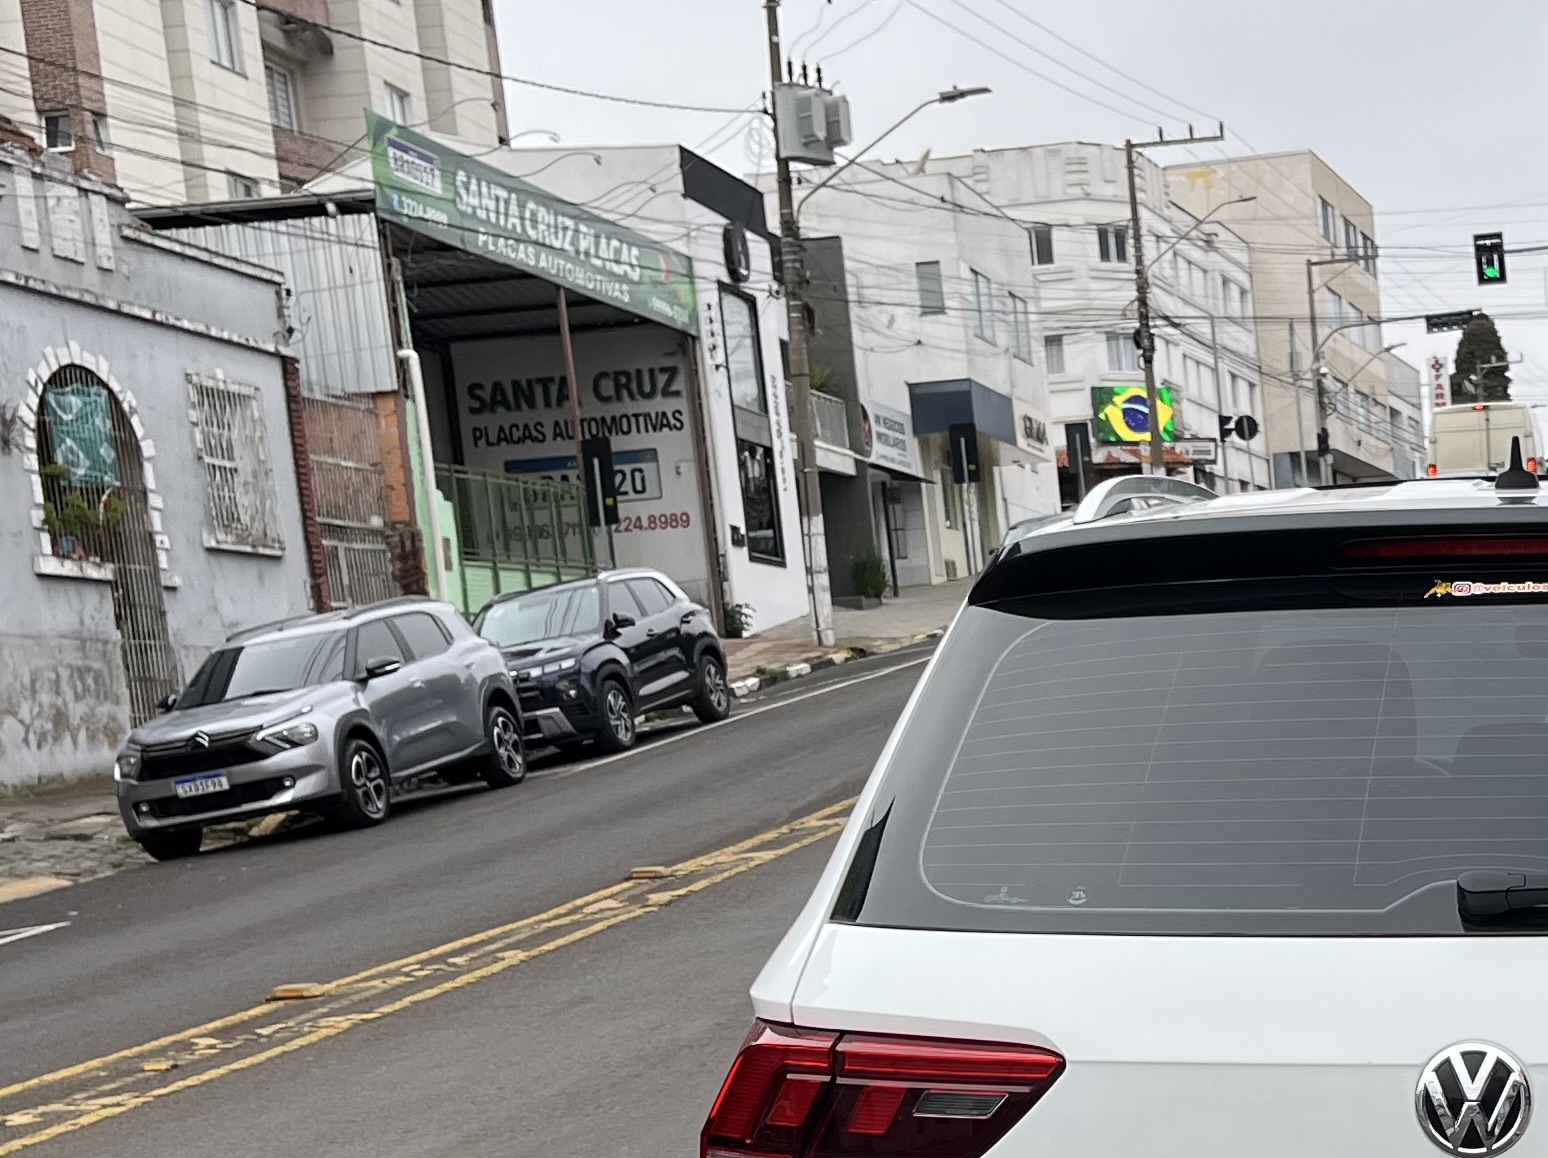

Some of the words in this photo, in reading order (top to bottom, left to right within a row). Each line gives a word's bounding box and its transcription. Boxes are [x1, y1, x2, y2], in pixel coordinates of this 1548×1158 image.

[456, 169, 523, 235] SANTA
[524, 200, 576, 256] CRUZ
[578, 222, 641, 282] PLACAS
[477, 226, 536, 269] PLACAS
[538, 252, 631, 304] AUTOMOTIVAS
[466, 375, 581, 416] SANTA
[592, 365, 682, 403] CRUZ
[472, 420, 546, 448] PLACAS
